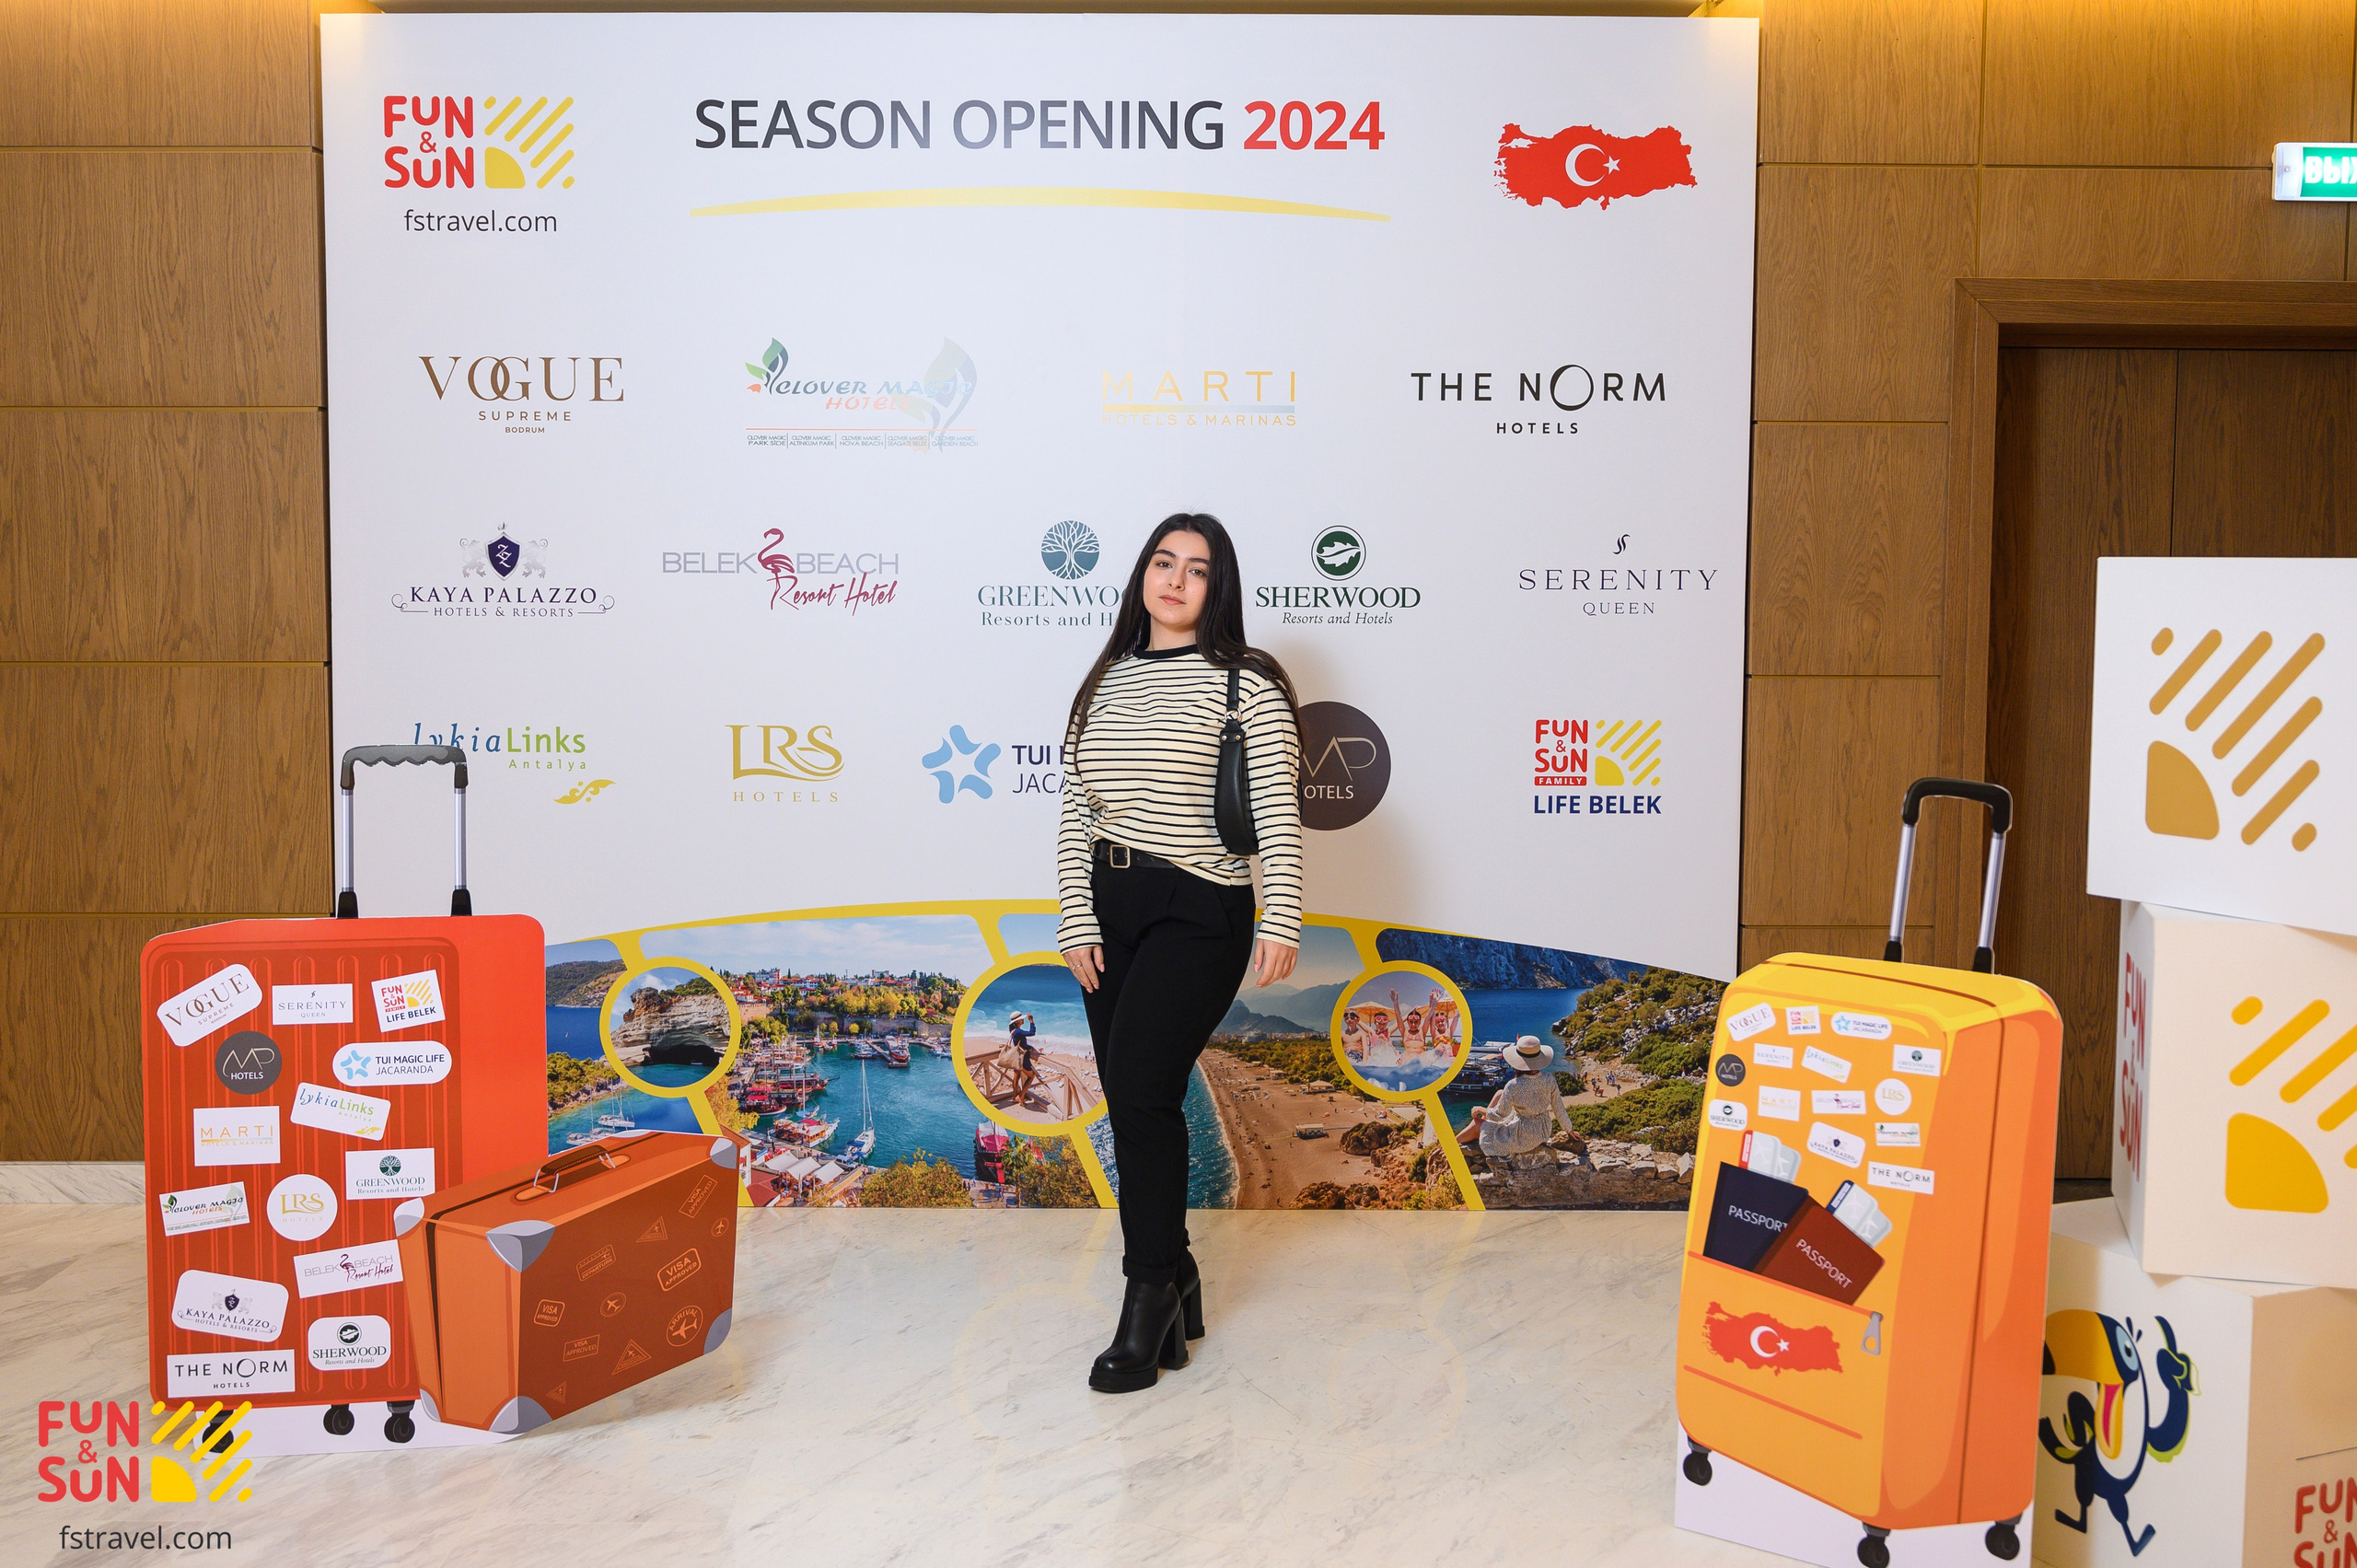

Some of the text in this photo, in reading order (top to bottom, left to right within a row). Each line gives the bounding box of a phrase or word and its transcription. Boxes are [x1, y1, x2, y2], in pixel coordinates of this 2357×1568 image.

[384, 96, 473, 138] FUN
[695, 99, 1385, 150] SEASON OPENING 2024
[420, 132, 436, 153] &
[385, 146, 474, 189] SUN
[404, 209, 557, 231] fstravel.com
[418, 356, 624, 401] VOGUE
[1102, 371, 1295, 401] MARTI
[775, 380, 973, 398] CLOVER MAGIC
[1411, 364, 1666, 412] THE NORM
[825, 397, 911, 411] HOTELS
[479, 411, 572, 422] SUPREME
[1102, 414, 1296, 426] HOTELS & MARINAS
[1496, 423, 1579, 434] HOTELS
[662, 552, 900, 575] BELEK BEACH
[1519, 569, 1718, 590] SERENITY
[411, 587, 598, 604] KAYA PALAZZO
[766, 572, 898, 616] Resort Hotel
[978, 585, 1127, 607] GREENWO
[1255, 587, 1422, 608] SHERWOOD
[434, 607, 574, 617] HOTELS & RESORTS
[1583, 602, 1655, 616] QUEEN
[981, 611, 1051, 626] Resorts
[1058, 611, 1091, 626] and
[1282, 612, 1393, 624] Resorts and Hotels
[1535, 719, 1588, 744] FUN
[725, 724, 845, 782] LRS
[1555, 739, 1566, 752] &
[1012, 745, 1051, 765] TUI
[1535, 749, 1588, 772] SUN
[508, 759, 586, 772] Antalya
[733, 791, 838, 802] HOTELS
[1301, 784, 1354, 799] OTELS
[1534, 796, 1662, 814] LIFE BELEK
[381, 984, 402, 997] FUN
[165, 973, 250, 1027] VOGUE
[278, 1001, 347, 1011] SERENITY
[383, 995, 405, 1008] SUN
[198, 1003, 235, 1026] SUPREME
[387, 1006, 436, 1023] LIFE BELEK
[376, 1054, 445, 1064] TUI MAGIC LIFE
[230, 1072, 264, 1080] HOTELS
[376, 1065, 434, 1075] JACARANDA
[338, 1111, 372, 1122] Antalya
[201, 1125, 273, 1138] MARTI
[355, 1177, 425, 1188] GREENWOOD
[281, 1192, 325, 1214] LRS
[688, 1188, 702, 1202] VISA
[174, 1202, 206, 1214] CLOVER
[304, 1255, 393, 1277] BELEK BEACH
[582, 1258, 613, 1279] DEPARTURE
[666, 1257, 691, 1276] VISA
[1795, 1238, 1852, 1288] PASSPORT
[665, 1261, 698, 1286] APPROVED
[543, 1305, 557, 1314] VISA
[186, 1308, 270, 1329] KAYA PALAZZO
[194, 1318, 220, 1327] HOTELS
[668, 1308, 698, 1330] ARRIVAL
[312, 1346, 387, 1359] SHERWOOD
[566, 1344, 597, 1356] APPROVED
[574, 1340, 587, 1348] VISA
[175, 1358, 288, 1377] THE NORM
[213, 1381, 250, 1389] HOTELS
[2323, 1519, 2338, 1544] &
